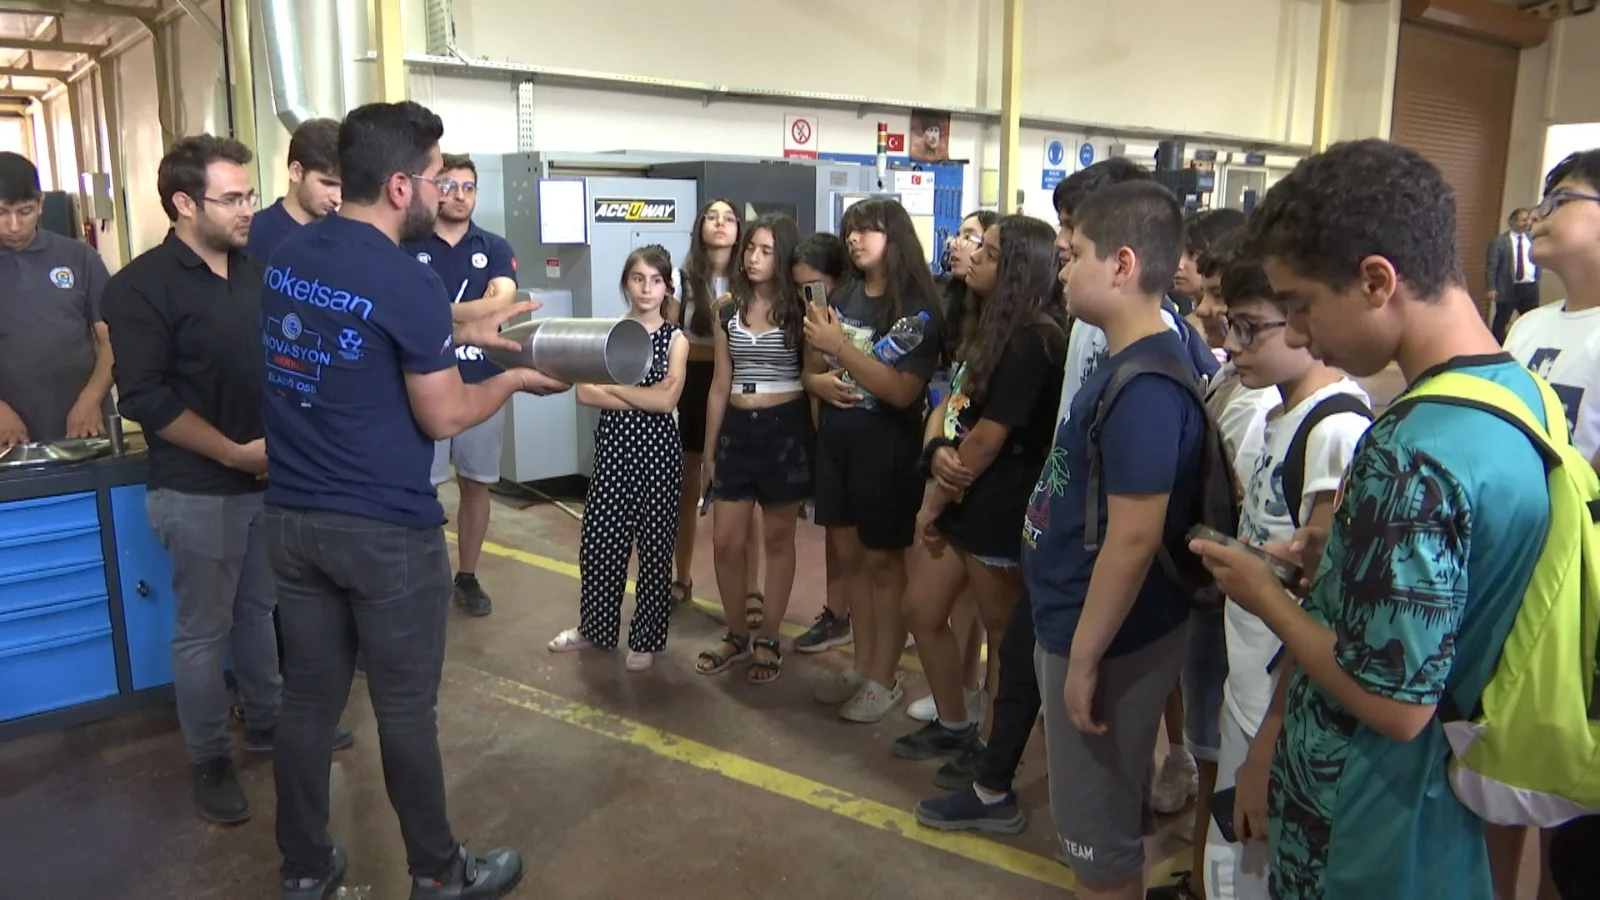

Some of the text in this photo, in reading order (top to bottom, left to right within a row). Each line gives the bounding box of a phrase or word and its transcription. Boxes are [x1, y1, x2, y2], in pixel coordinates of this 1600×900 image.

[595, 203, 674, 218] ACCUWAY
[263, 266, 373, 321] roketsan
[1064, 838, 1093, 861] TEAM
